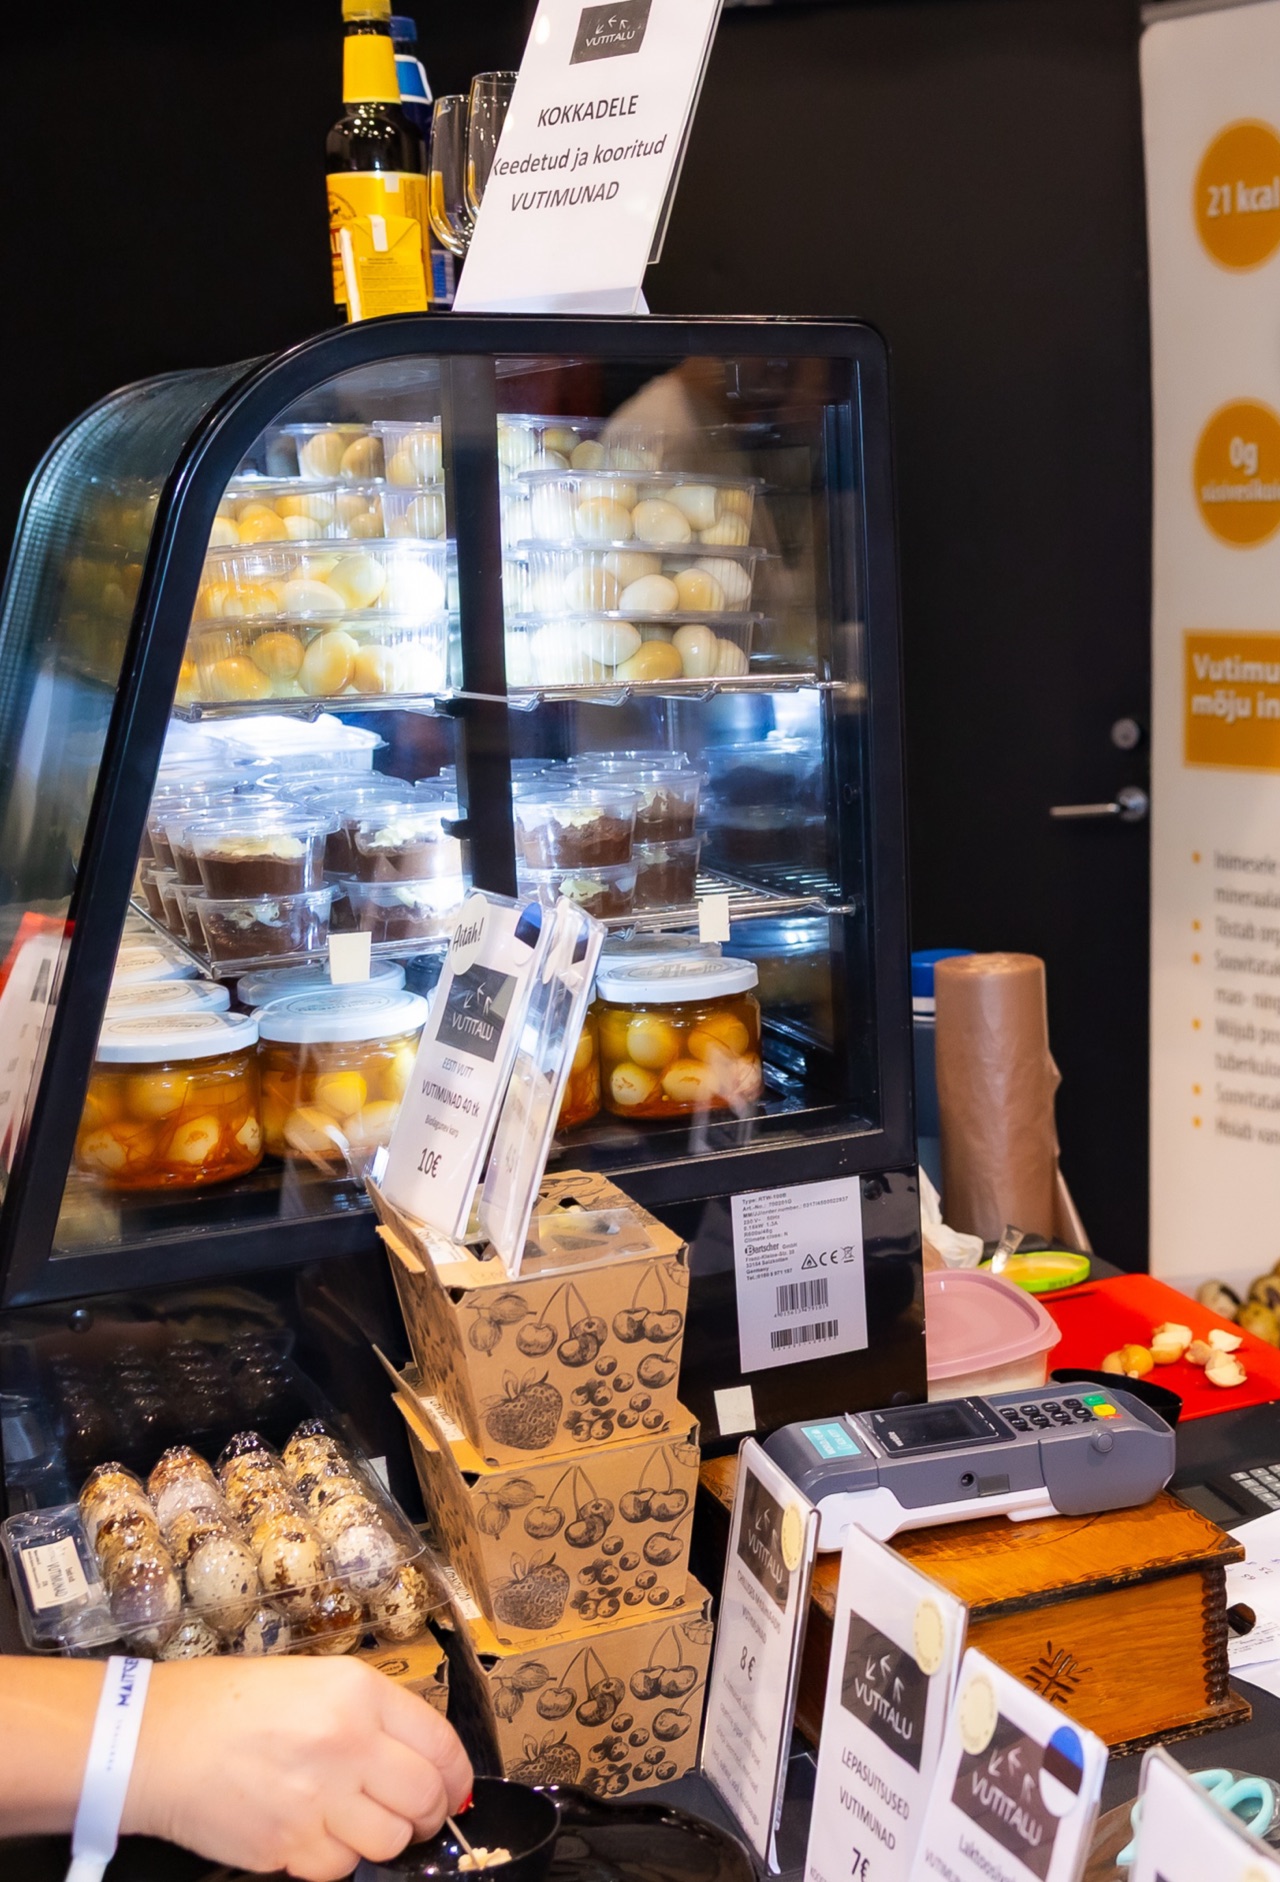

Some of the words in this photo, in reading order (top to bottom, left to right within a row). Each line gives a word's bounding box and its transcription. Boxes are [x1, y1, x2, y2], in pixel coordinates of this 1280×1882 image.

[585, 30, 636, 47] VUTITALU
[537, 95, 639, 127] KOKKADELE
[570, 147, 589, 172] ja
[593, 133, 668, 165] kooritud
[511, 180, 620, 212] VUTIMUNAD
[1206, 184, 1232, 217] 21
[1229, 436, 1259, 475] 0g
[1191, 689, 1252, 725] mõju
[453, 916, 485, 949] Aitäh!
[450, 1011, 495, 1042] VUTITALU
[441, 1056, 457, 1074] EESTI
[456, 1061, 475, 1079] VUTT
[421, 1079, 463, 1110] VUTIMUNAD
[461, 1097, 472, 1115] 40
[471, 1101, 480, 1118] tk
[417, 1147, 442, 1179] 10€
[745, 1241, 780, 1257] Bartscher
[747, 1527, 784, 1585] VUTITALU
[740, 1645, 748, 1671] 8
[853, 1675, 914, 1742] VUTITALU
[841, 1746, 910, 1821] LEPASUITSUSED
[839, 1785, 897, 1851] VUTIMUNAD
[972, 1768, 1043, 1847] VUTITALU
